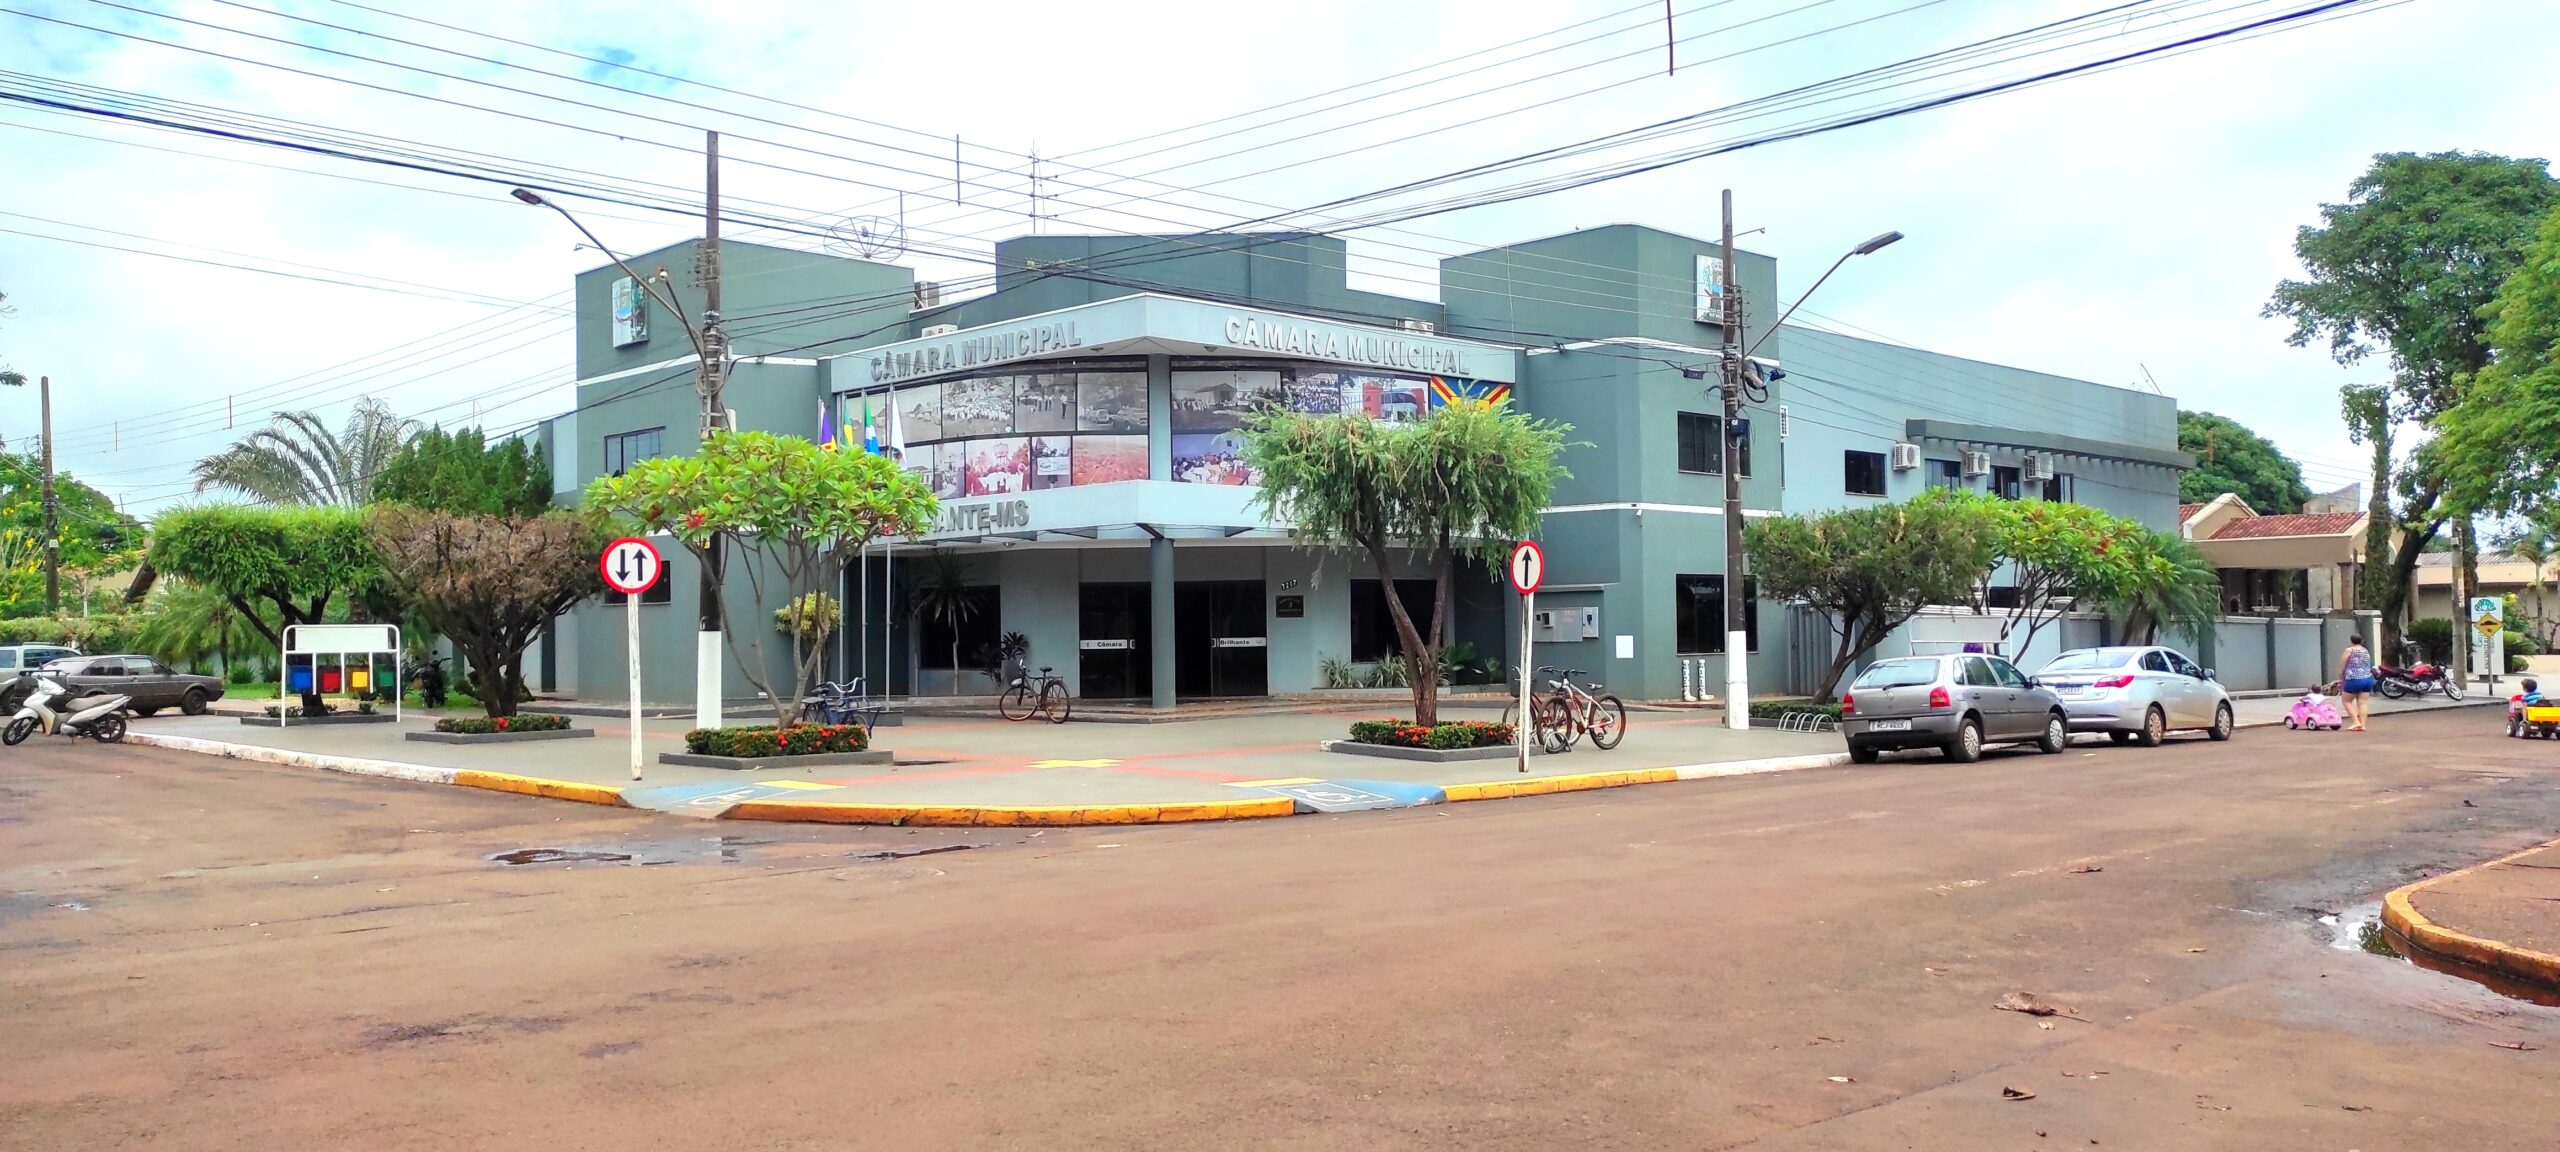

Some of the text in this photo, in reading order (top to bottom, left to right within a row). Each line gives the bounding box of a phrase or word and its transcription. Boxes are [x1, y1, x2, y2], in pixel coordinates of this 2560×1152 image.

[871, 320, 1082, 382] CÂMARA MUNICIPAL
[1225, 316, 1470, 375] CÂMARA MUNICIPAL
